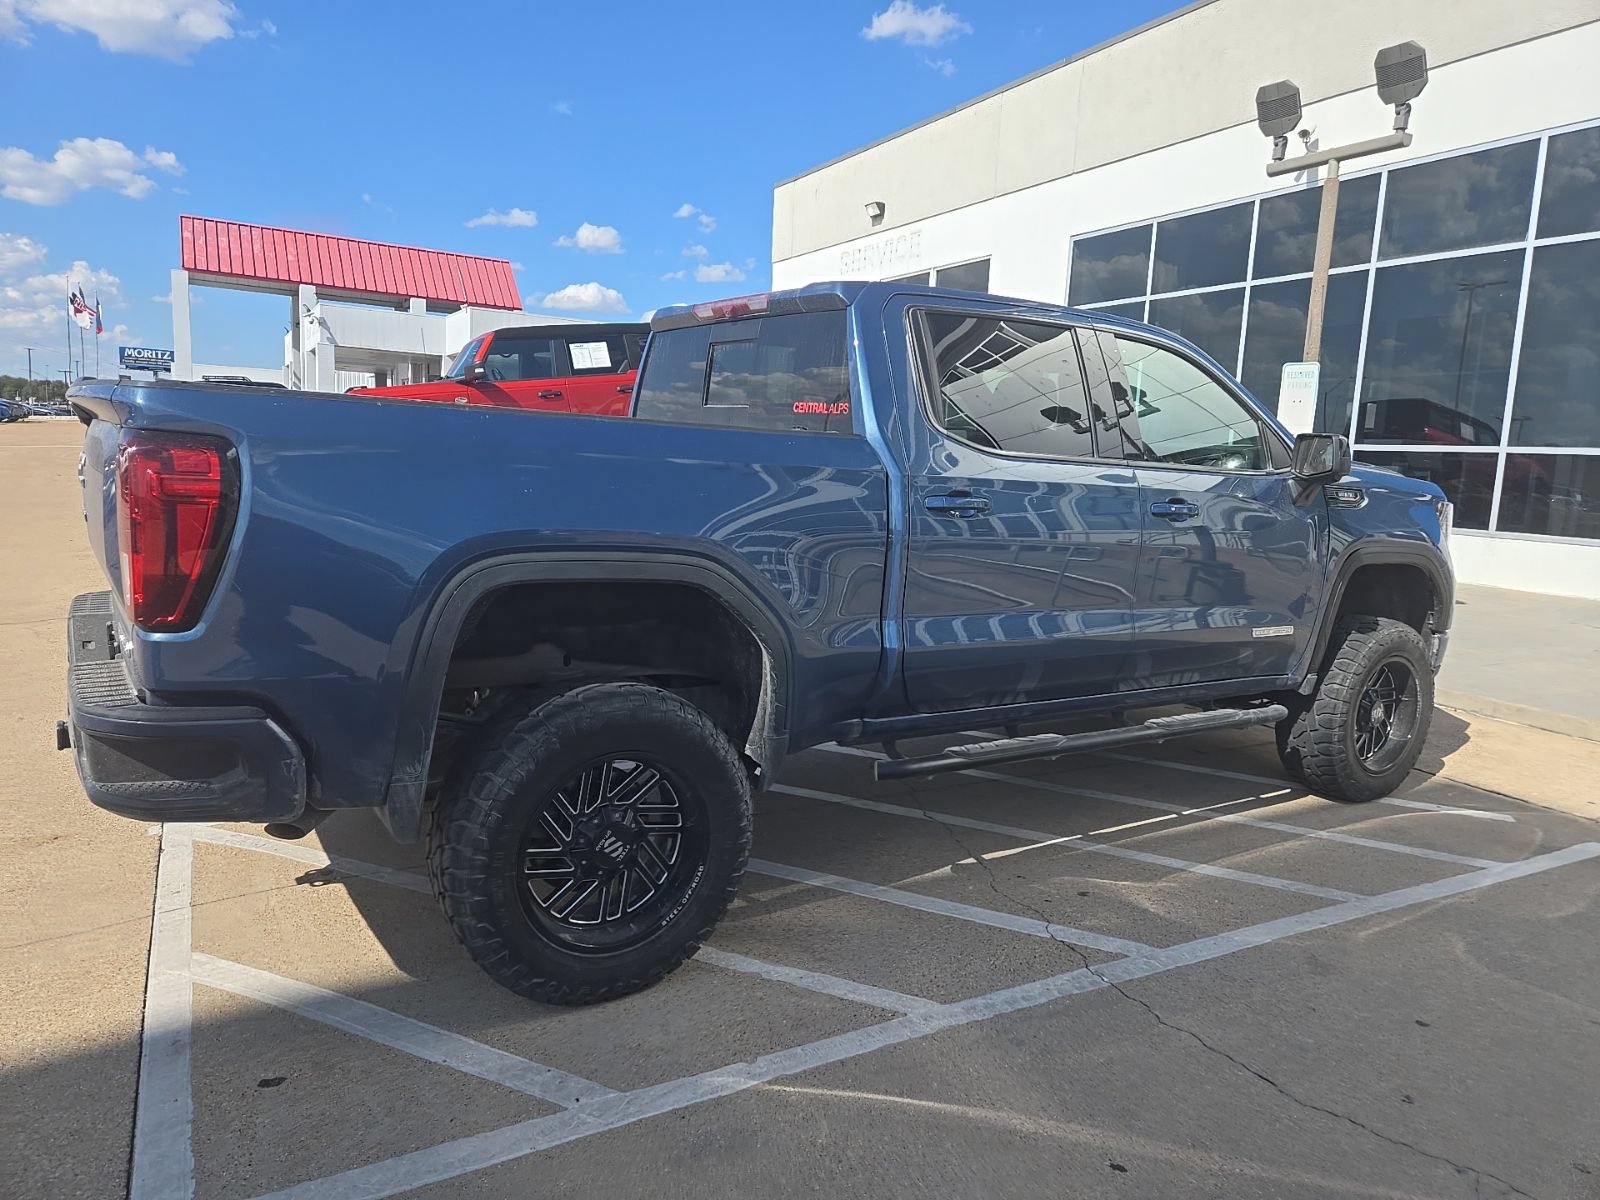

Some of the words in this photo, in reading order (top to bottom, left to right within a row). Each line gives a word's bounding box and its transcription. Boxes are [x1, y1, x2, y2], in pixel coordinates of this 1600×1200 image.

[124, 348, 171, 359] MORITZ
[793, 401, 828, 414] CENTRAL
[828, 402, 849, 415] ALPS
[661, 905, 682, 926] STEEL
